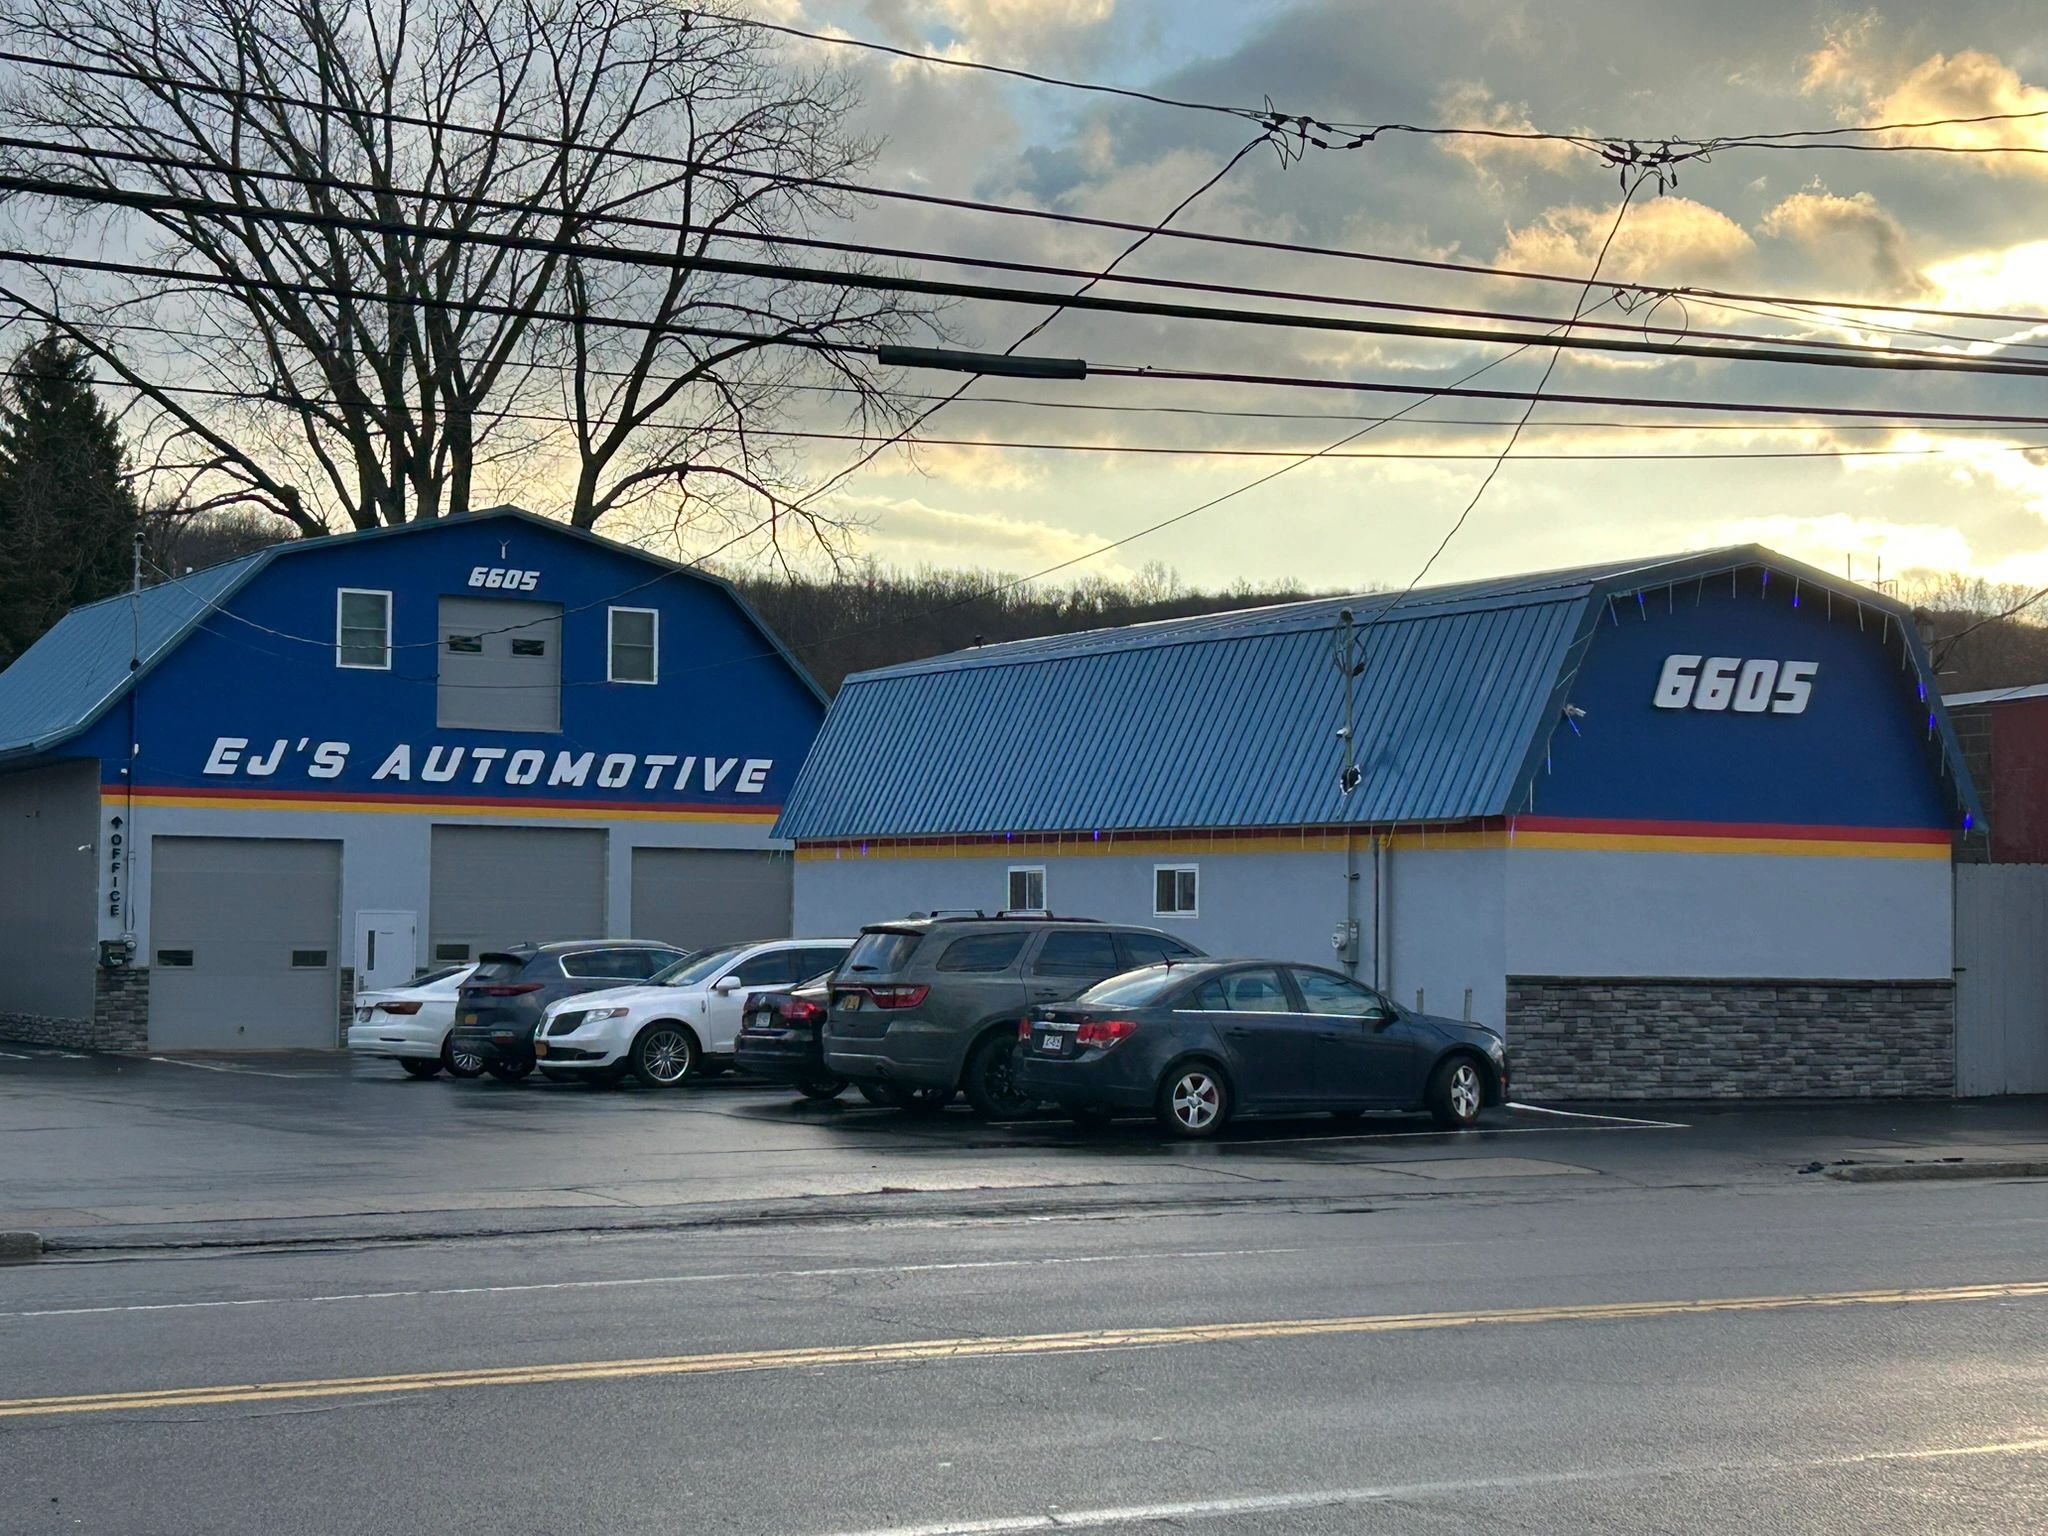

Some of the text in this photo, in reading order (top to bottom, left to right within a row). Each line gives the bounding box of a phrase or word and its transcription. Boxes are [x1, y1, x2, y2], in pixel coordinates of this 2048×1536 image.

[468, 566, 541, 591] 6605
[1654, 654, 1819, 714] 6605
[203, 736, 774, 793] EJ'S AUTOMOTIVE
[109, 833, 123, 917] OFFICE
